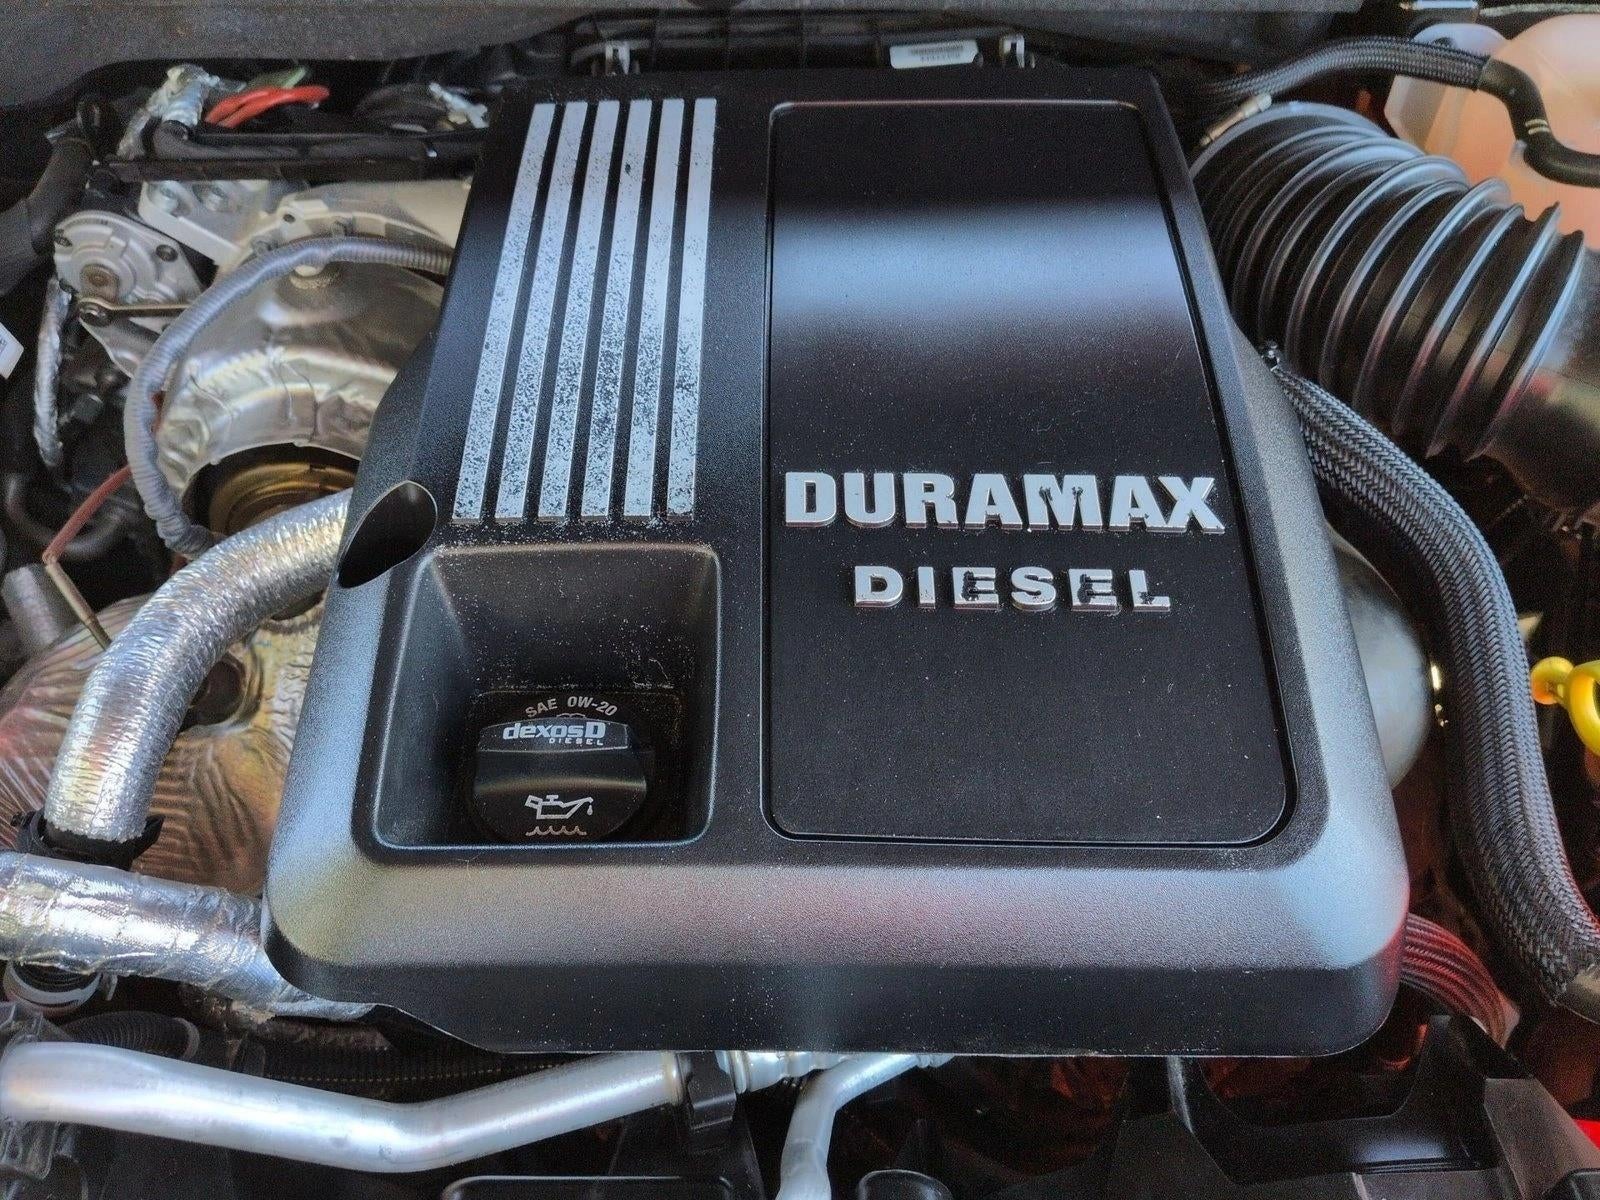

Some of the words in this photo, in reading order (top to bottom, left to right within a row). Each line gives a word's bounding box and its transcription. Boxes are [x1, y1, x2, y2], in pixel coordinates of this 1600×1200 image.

[785, 472, 1225, 534] DURAMAX
[854, 566, 1171, 612] DIESEL
[525, 698, 558, 717] SAE
[567, 696, 617, 717] 0W-20
[549, 738, 604, 746] DIESEL
